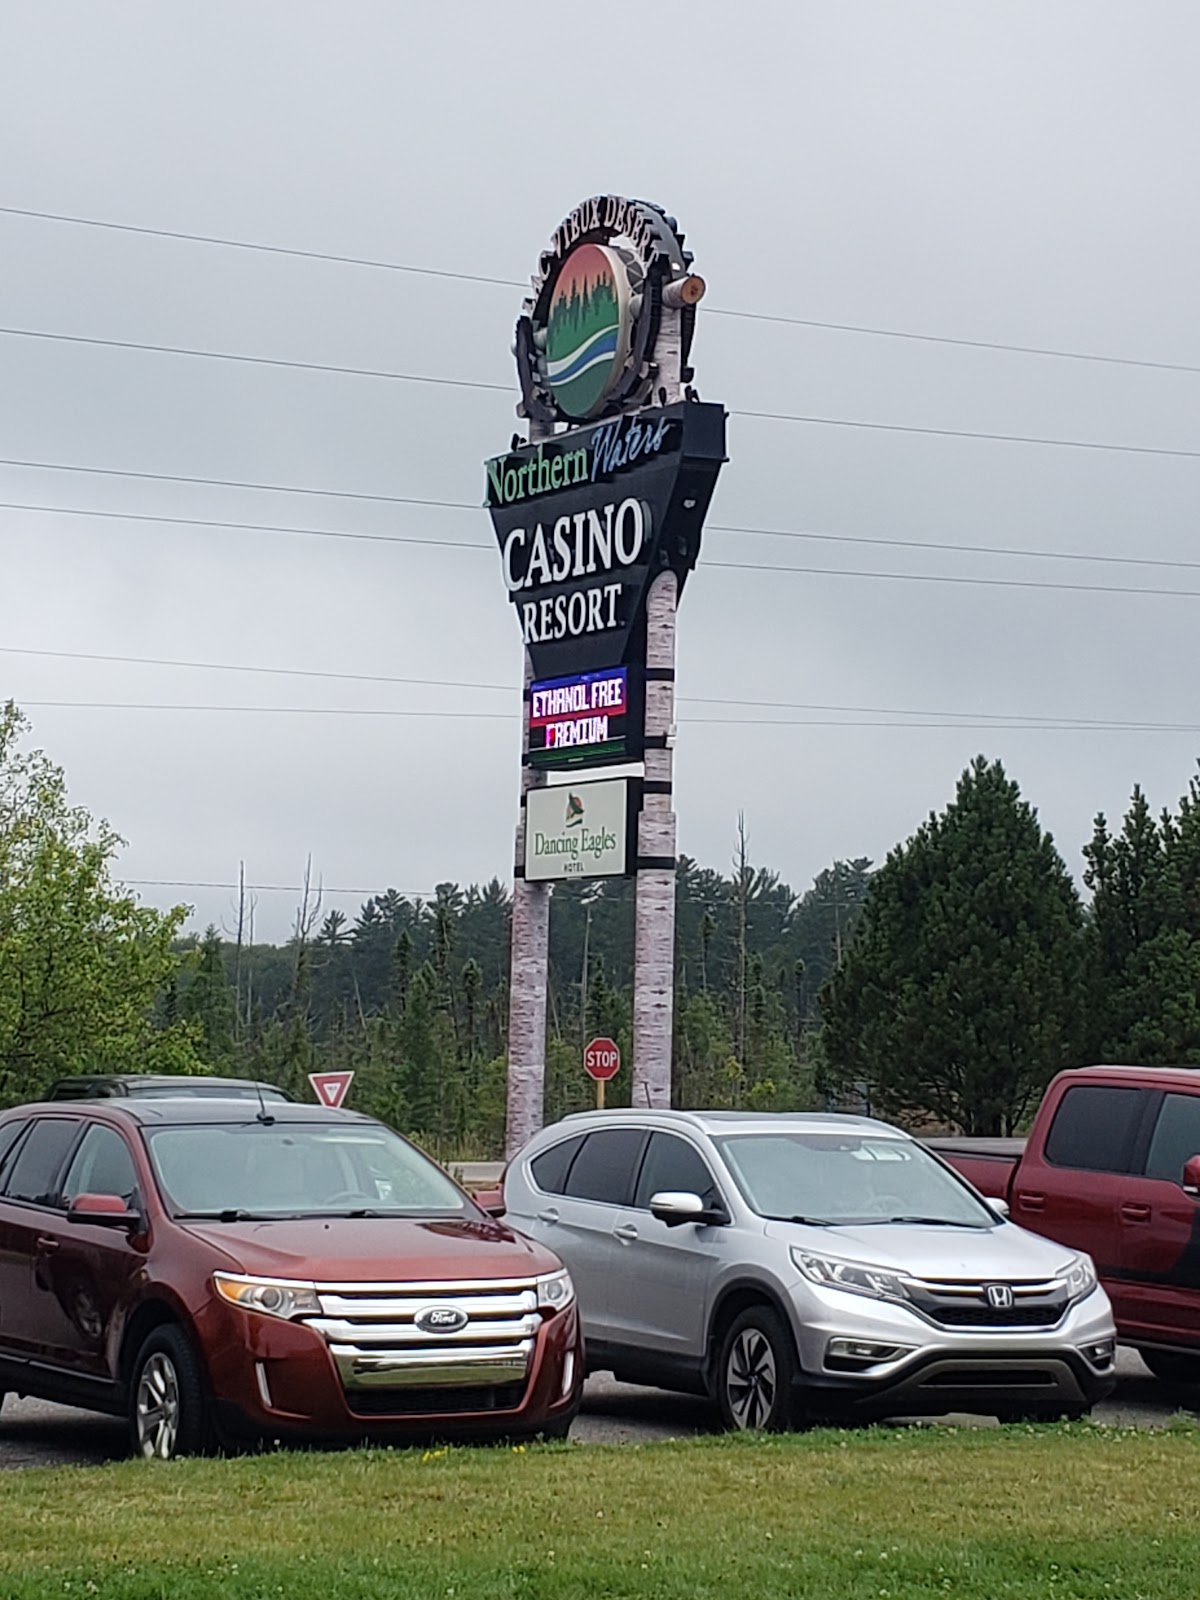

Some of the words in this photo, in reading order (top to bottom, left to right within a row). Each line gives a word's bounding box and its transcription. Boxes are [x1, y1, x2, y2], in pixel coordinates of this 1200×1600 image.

[483, 443, 588, 507] Northern
[591, 416, 669, 482] Waters
[503, 498, 643, 592] CASINO
[522, 583, 622, 645] RESORT
[533, 684, 590, 718] ETHANOL
[591, 678, 623, 708] FREE
[535, 832, 578, 860] Dancing
[581, 826, 616, 858] Eagles
[587, 1051, 617, 1067] STOP
